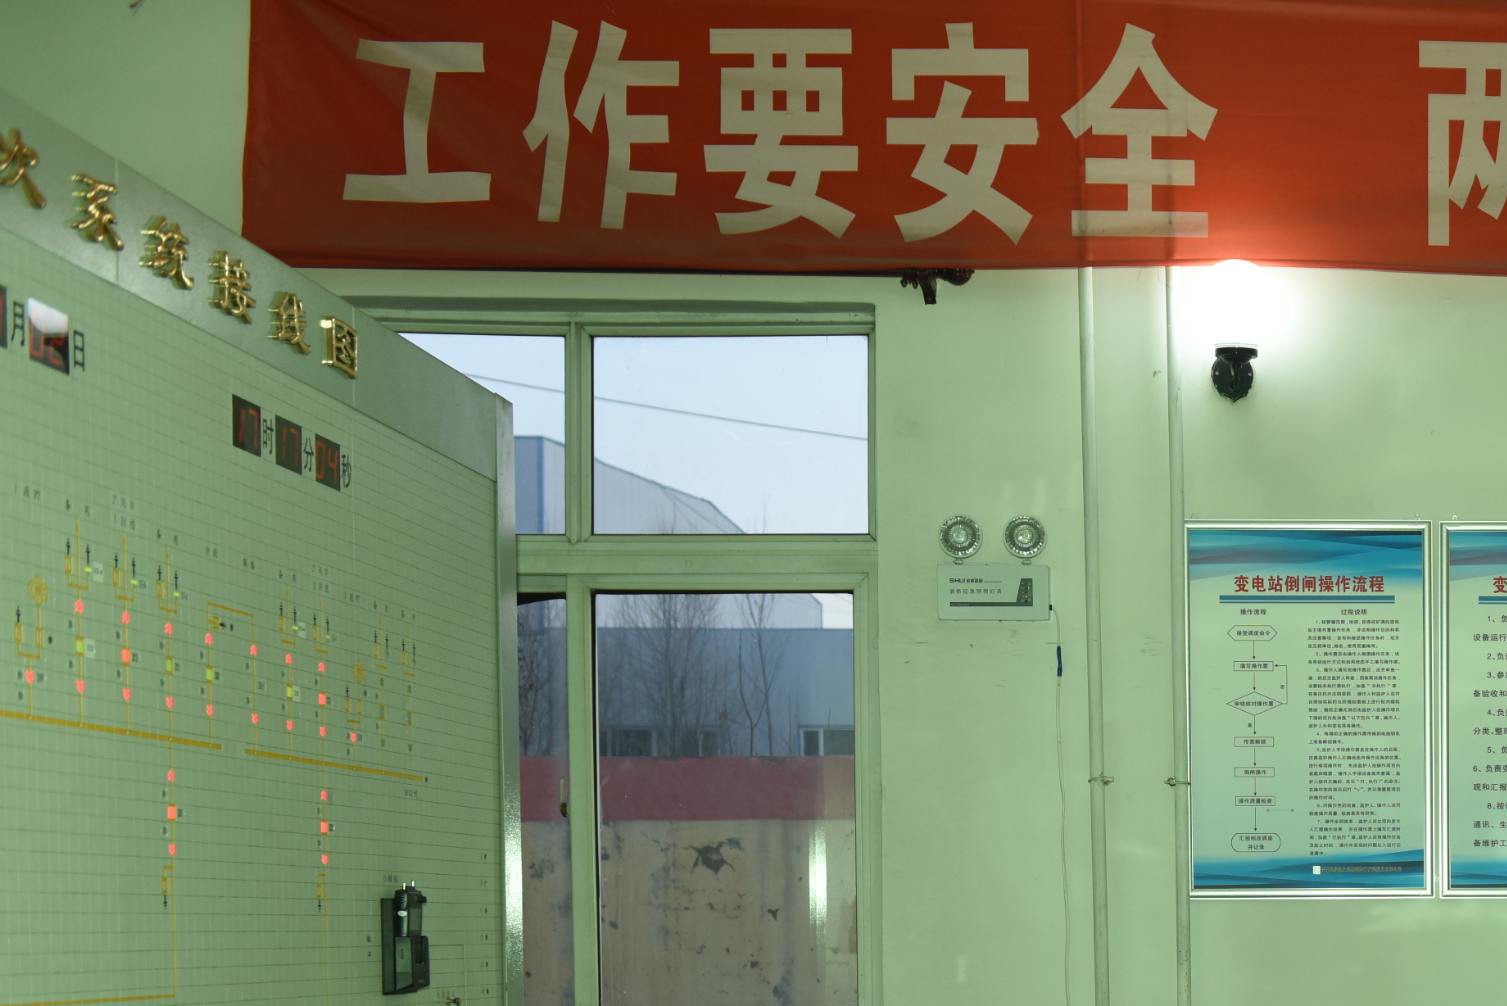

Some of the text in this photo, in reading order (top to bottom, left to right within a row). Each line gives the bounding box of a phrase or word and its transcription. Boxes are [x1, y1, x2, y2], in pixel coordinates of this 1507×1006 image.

[342, 20, 1218, 245] 工作要安全
[1233, 575, 1386, 593] 变电站倒闸操作流程
